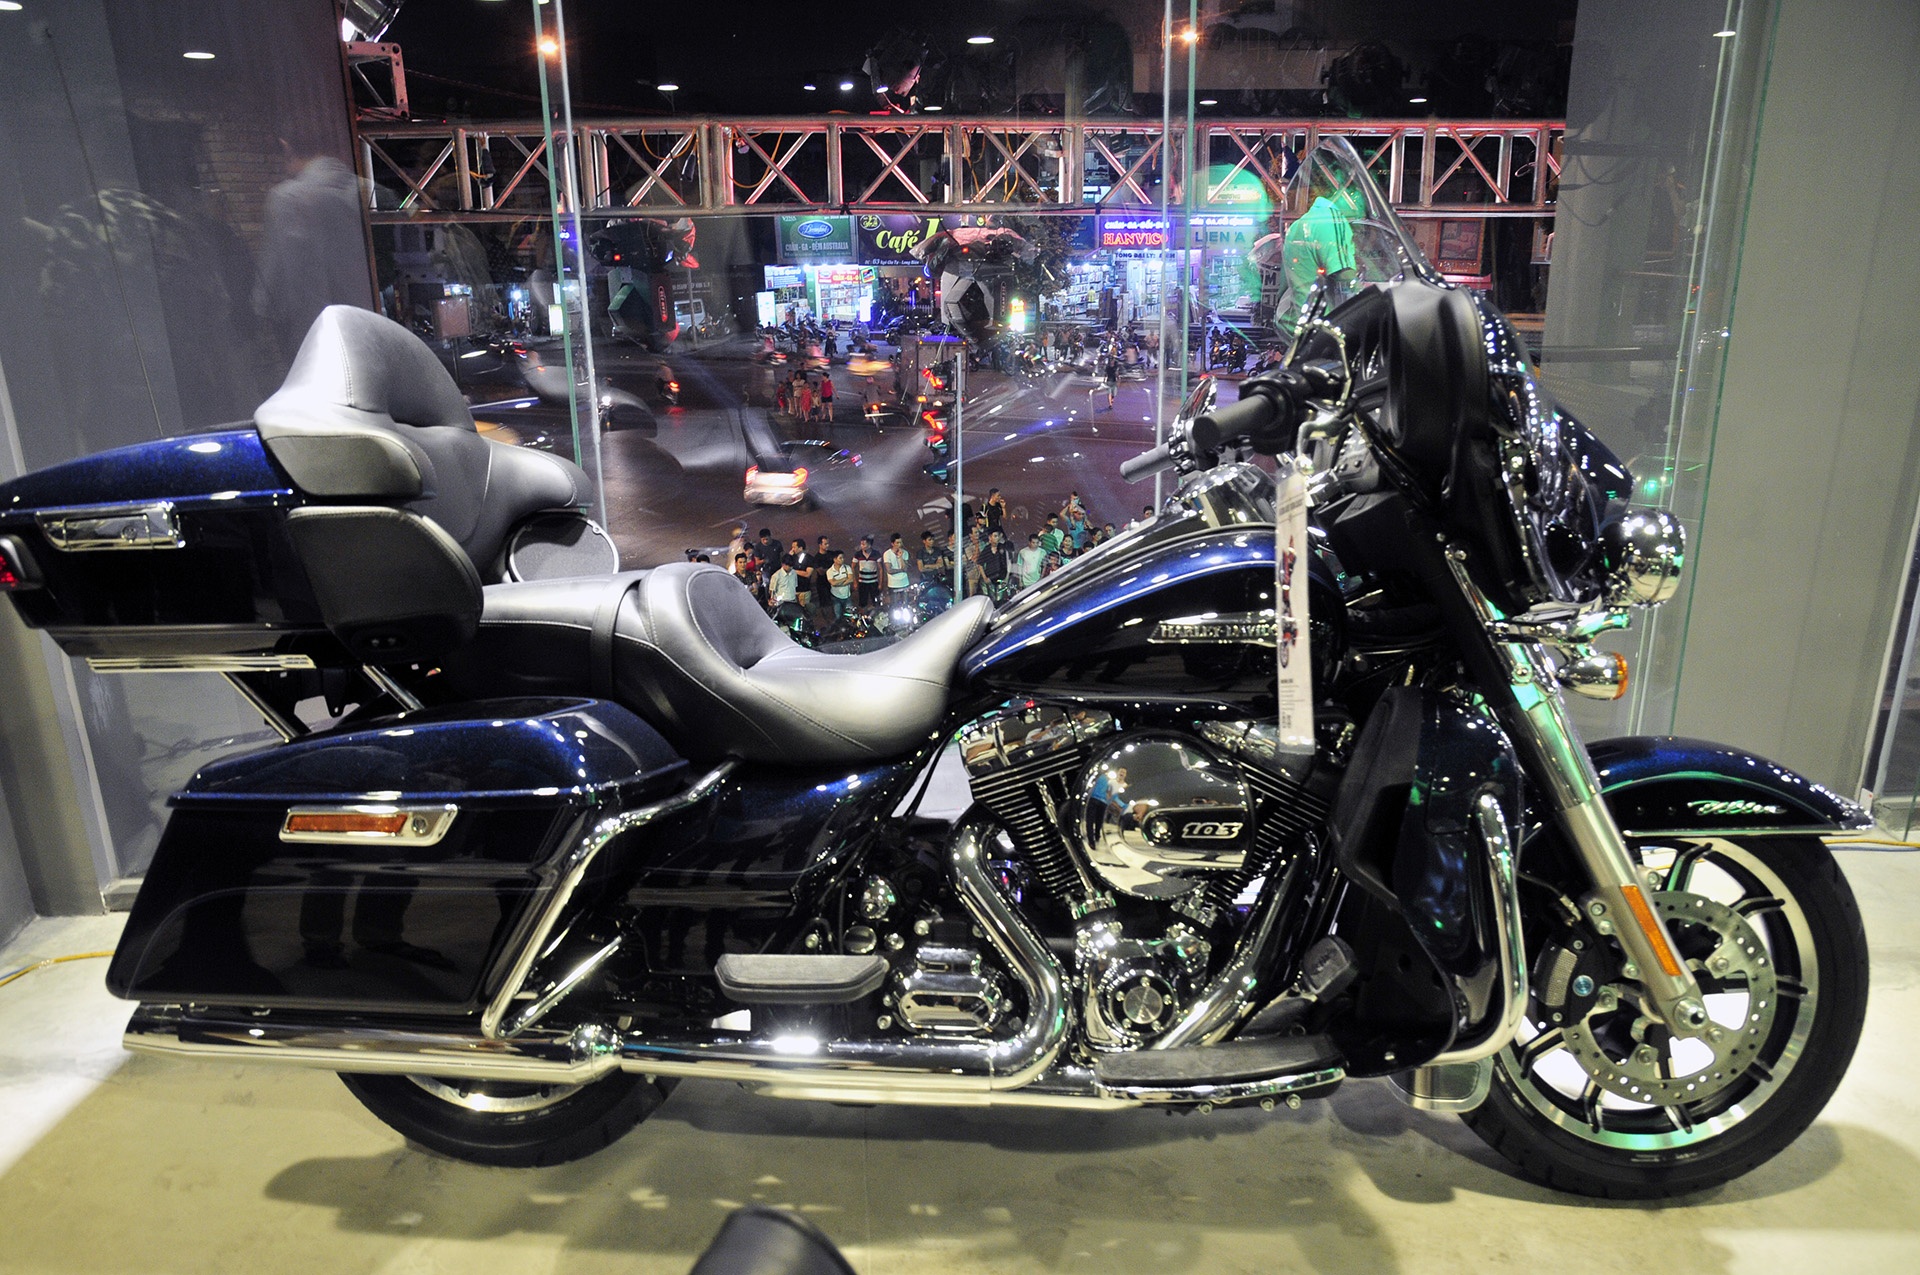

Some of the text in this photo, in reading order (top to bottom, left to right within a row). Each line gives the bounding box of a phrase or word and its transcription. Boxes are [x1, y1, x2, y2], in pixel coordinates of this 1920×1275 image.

[823, 242, 849, 250] AUSTRALIA
[876, 230, 921, 254] Café
[1182, 822, 1243, 839] 103
